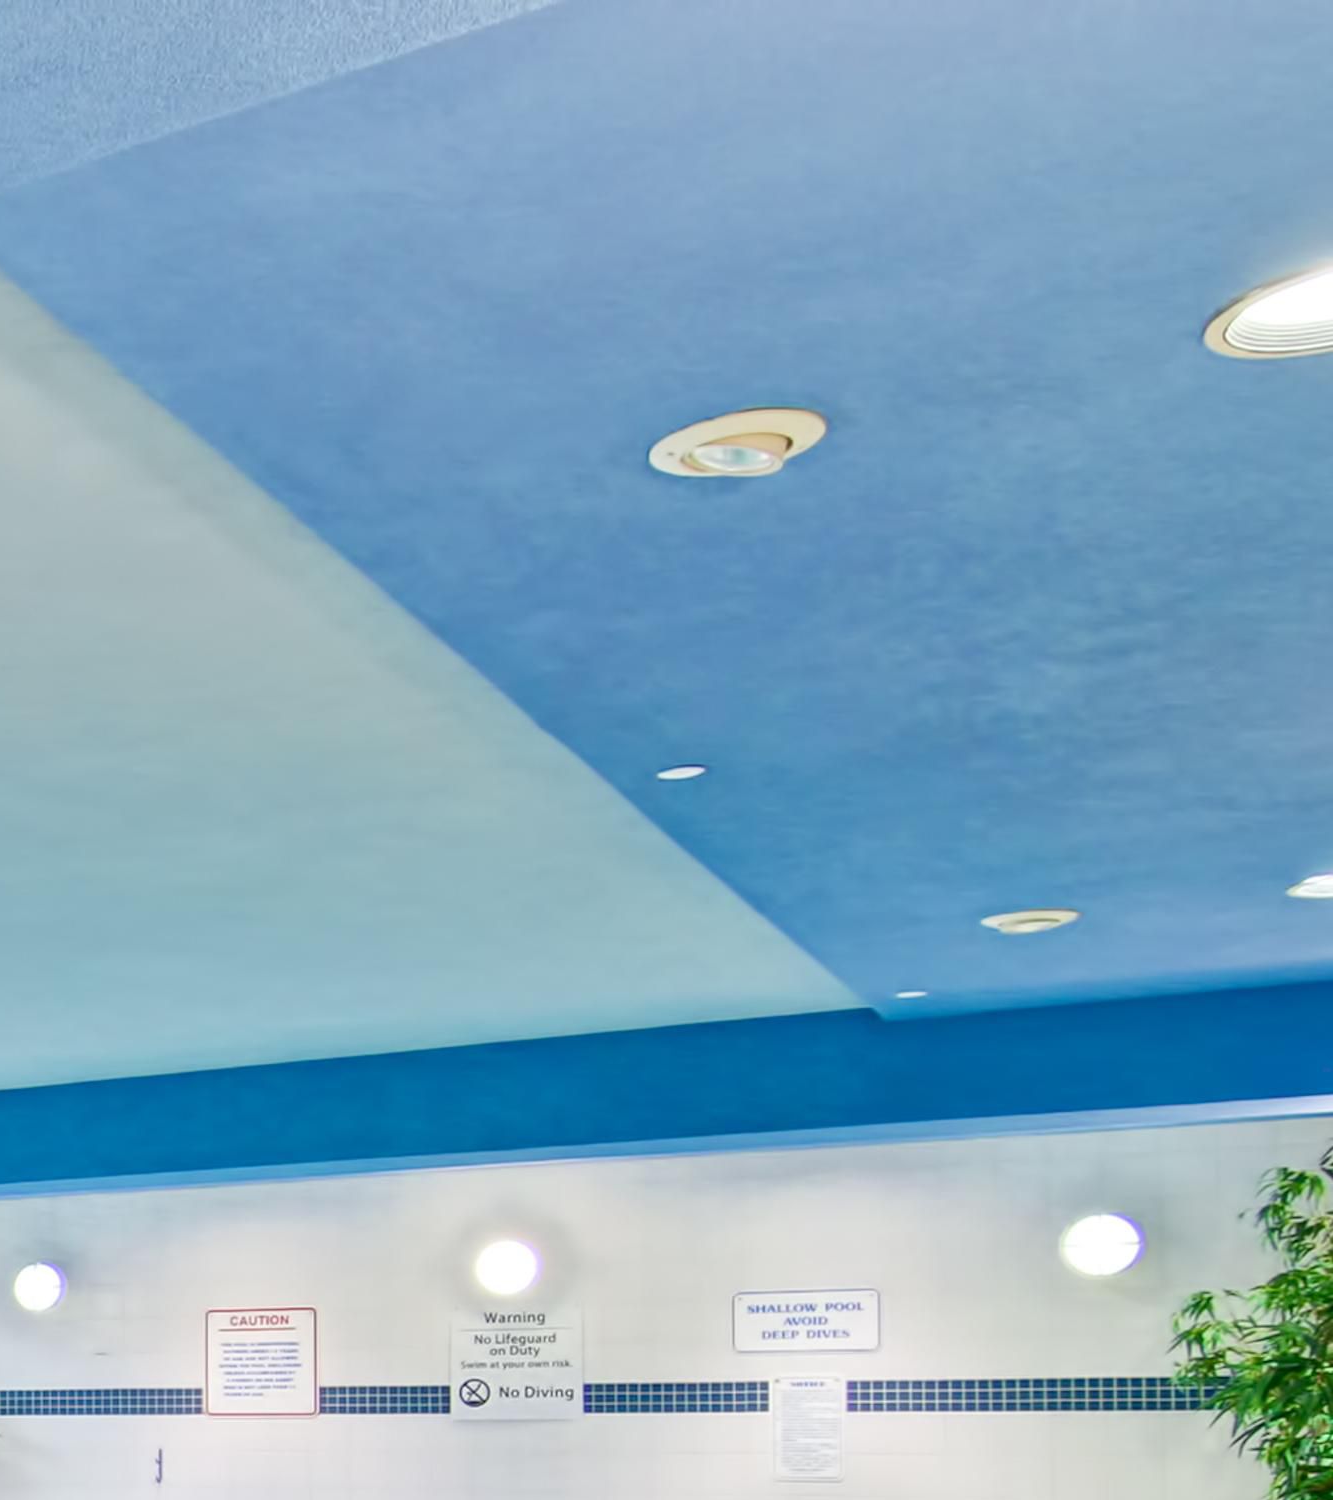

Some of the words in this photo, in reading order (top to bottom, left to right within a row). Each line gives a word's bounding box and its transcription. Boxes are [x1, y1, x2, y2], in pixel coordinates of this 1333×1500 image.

[747, 1303, 818, 1314] SHALLOW
[825, 1301, 864, 1312] POOL
[229, 1315, 290, 1327] CAUTION
[484, 1311, 546, 1326] Warning
[783, 1316, 829, 1326] AVOID
[474, 1334, 492, 1345] No
[494, 1332, 557, 1346] Lifeguard
[761, 1330, 800, 1340] DEEP
[806, 1329, 851, 1339] DIVES
[489, 1347, 506, 1356] on
[509, 1345, 541, 1358] Duty
[461, 1361, 487, 1370] Swim
[489, 1360, 500, 1369] at
[502, 1361, 525, 1371] your
[499, 1386, 520, 1398] No
[524, 1386, 574, 1401] Diving
